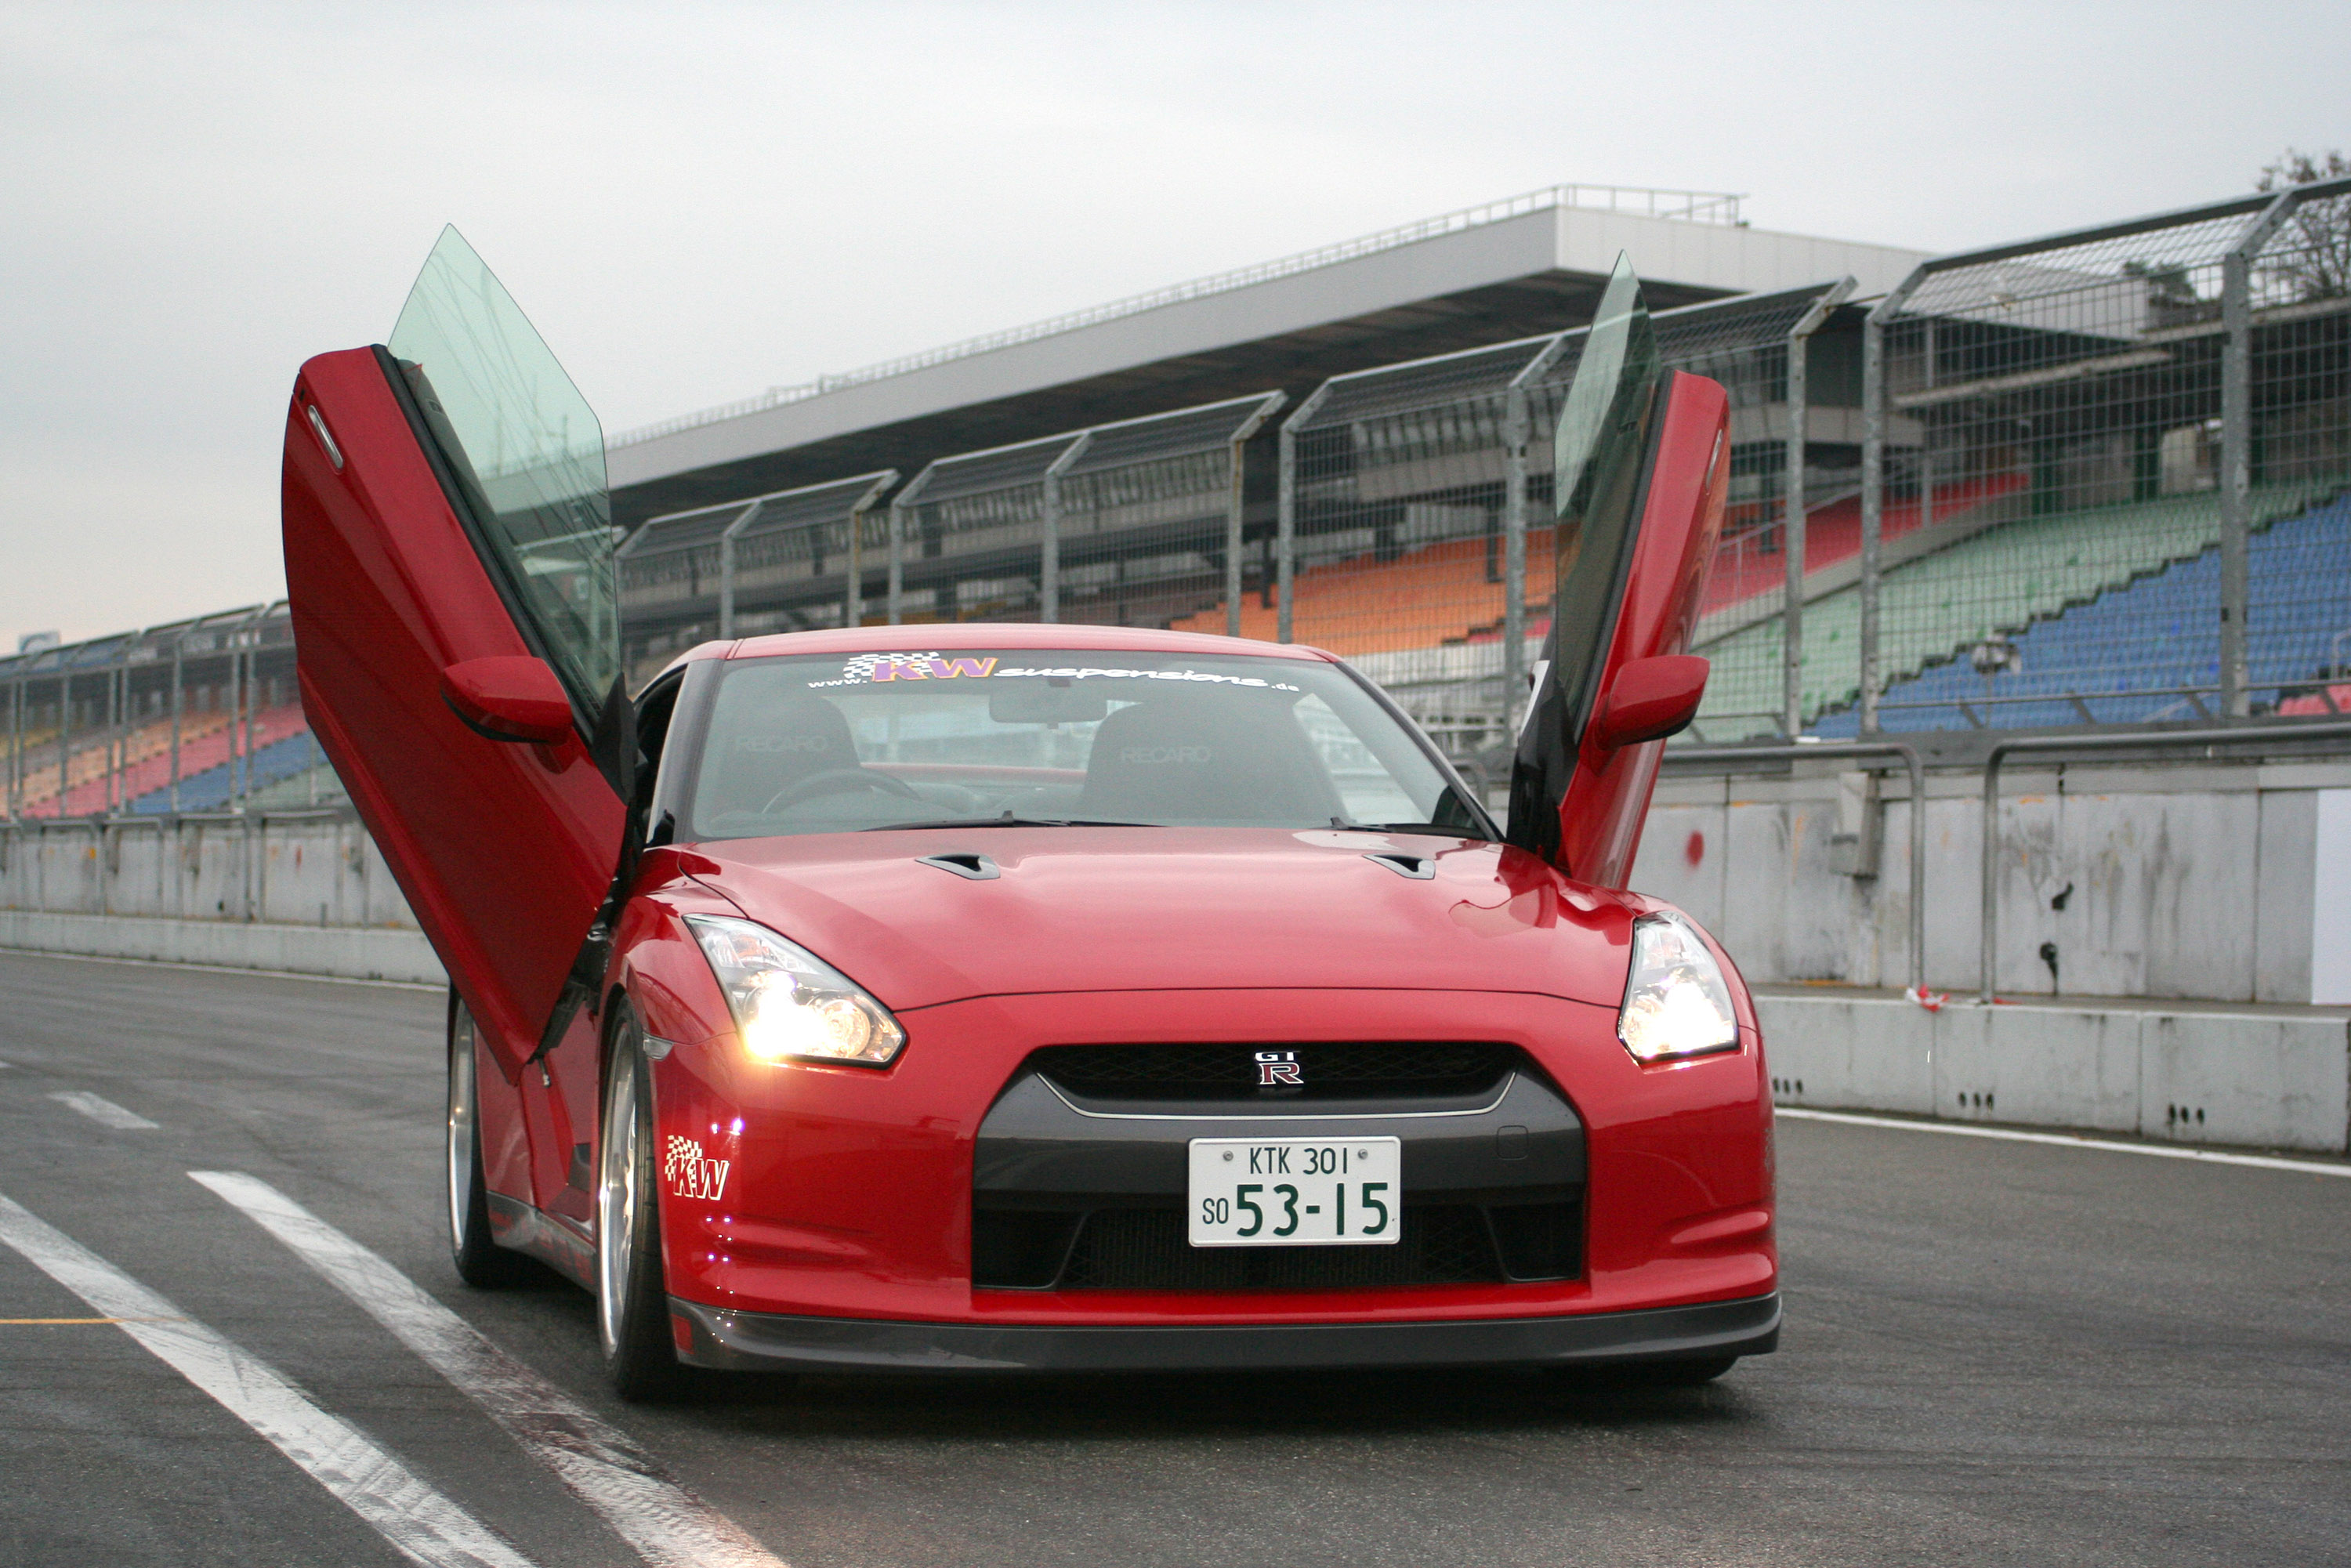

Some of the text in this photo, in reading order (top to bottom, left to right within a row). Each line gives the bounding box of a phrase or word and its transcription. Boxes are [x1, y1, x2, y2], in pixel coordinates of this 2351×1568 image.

[735, 735, 828, 752] RECARO
[1121, 745, 1212, 763] RECARO
[1259, 1062, 1304, 1085] R
[1249, 1147, 1348, 1175] KTK 301
[673, 1156, 730, 1200] KW
[1236, 1182, 1389, 1237] 53-15
